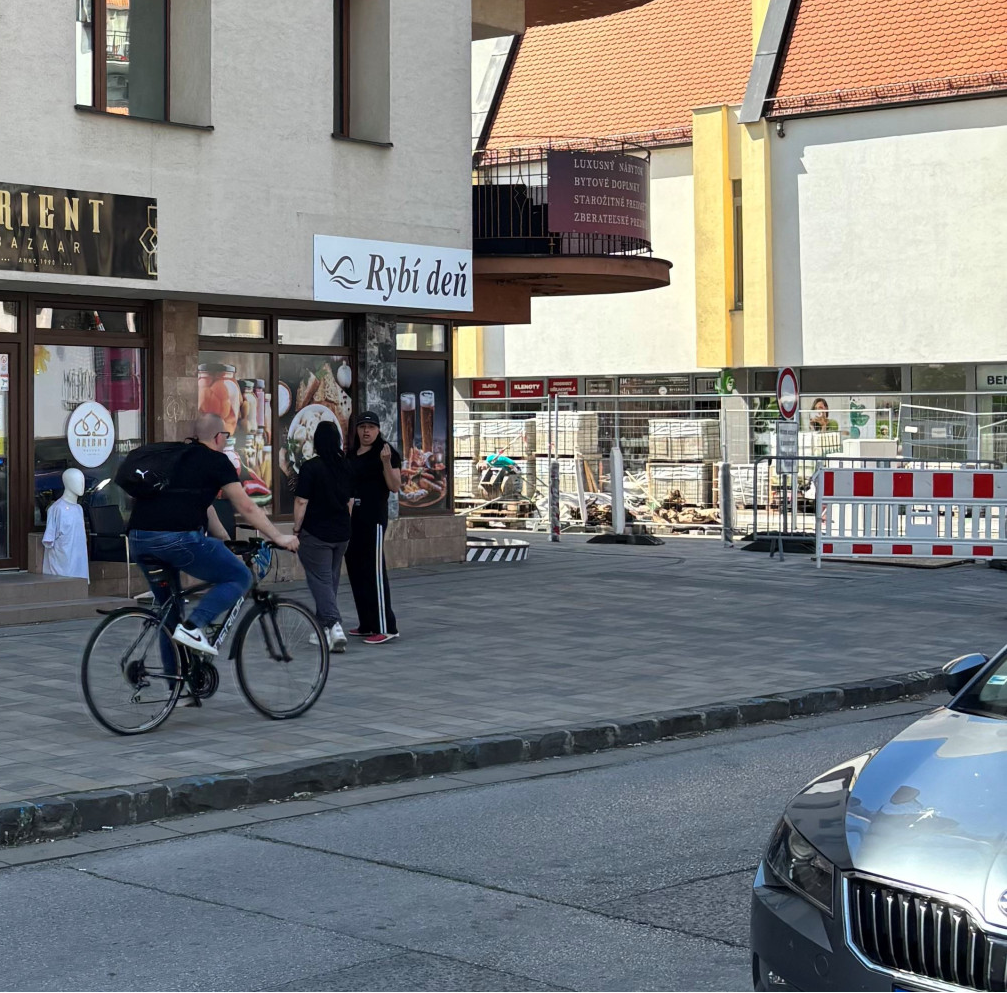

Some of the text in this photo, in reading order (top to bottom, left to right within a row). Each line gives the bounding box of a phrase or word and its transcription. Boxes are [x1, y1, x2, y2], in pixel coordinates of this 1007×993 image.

[573, 158, 615, 171] LUXUSNÝ
[573, 176, 610, 188] BYTOVÉ
[573, 194, 625, 208] STAROŽITNÉ
[365, 253, 468, 302] Rybí deň
